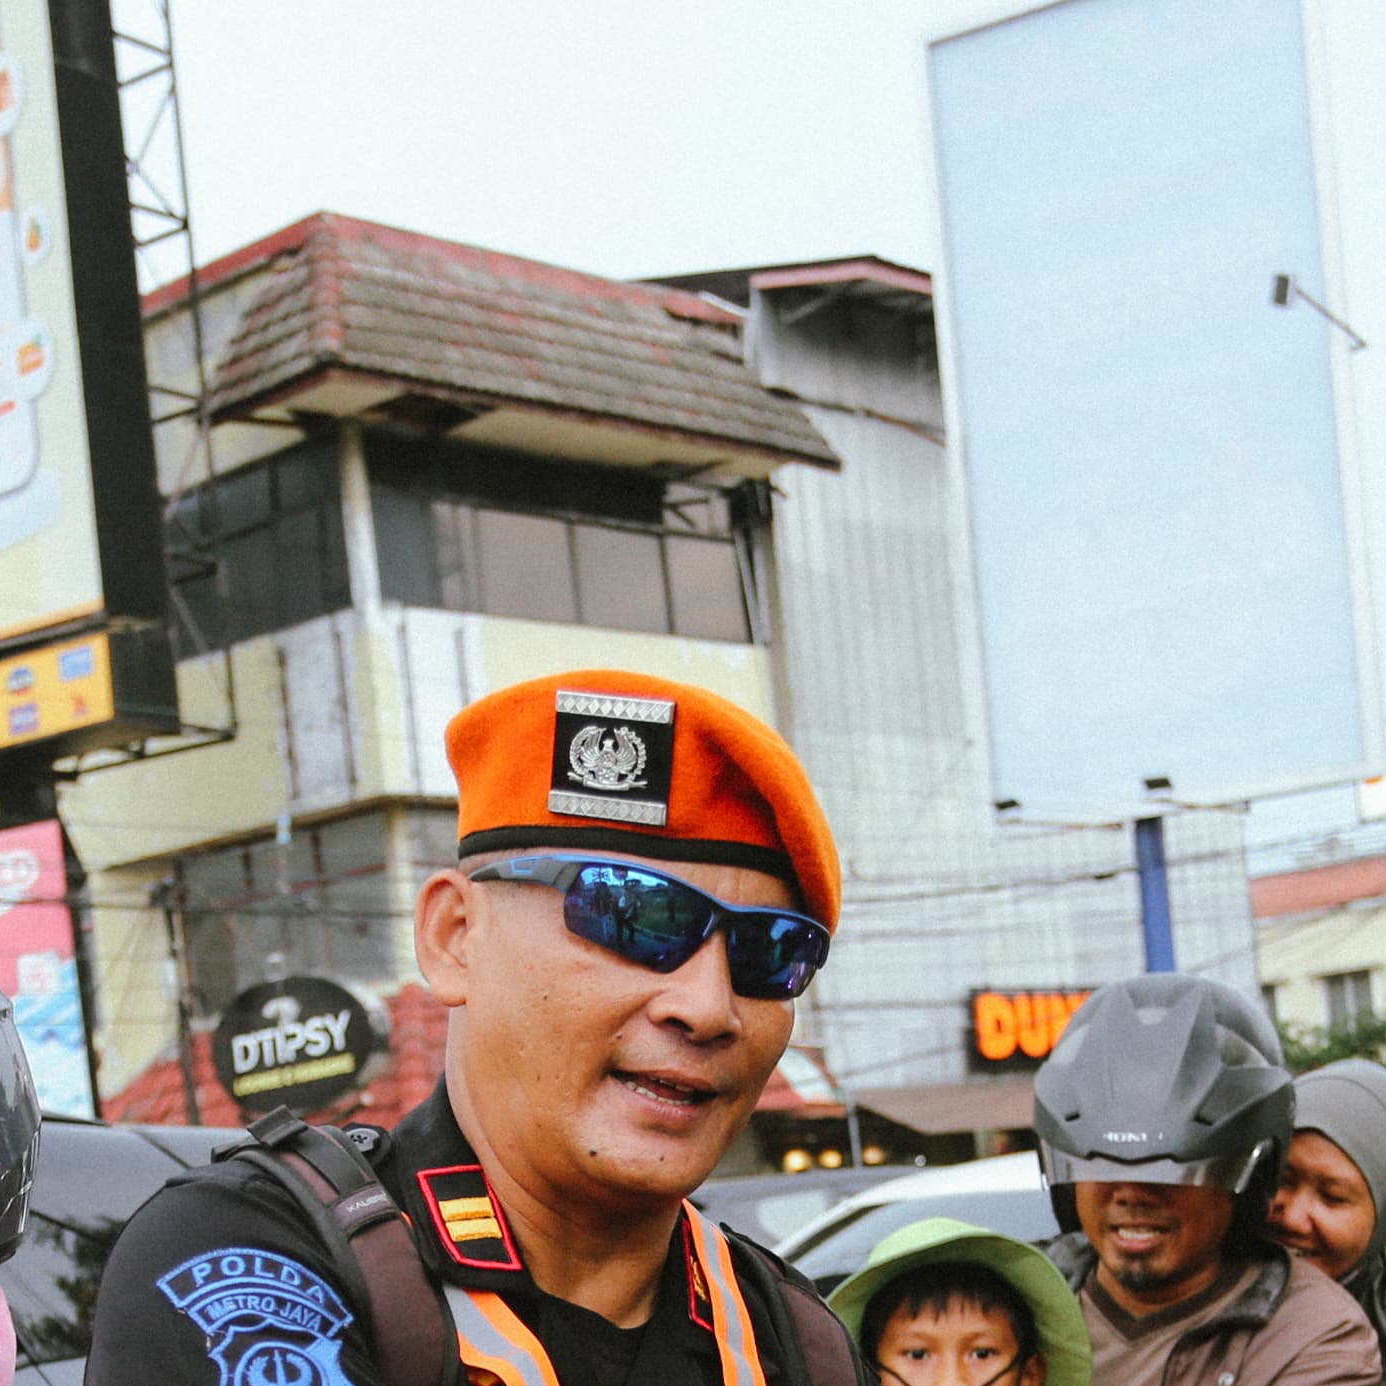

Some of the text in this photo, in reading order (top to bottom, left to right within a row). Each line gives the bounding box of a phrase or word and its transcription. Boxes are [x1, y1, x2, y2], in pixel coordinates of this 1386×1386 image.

[231, 1009, 352, 1075] DTIPSY
[973, 990, 1092, 1060] DUN
[191, 1255, 326, 1307] POLDA
[279, 1305, 323, 1333] JAYA
